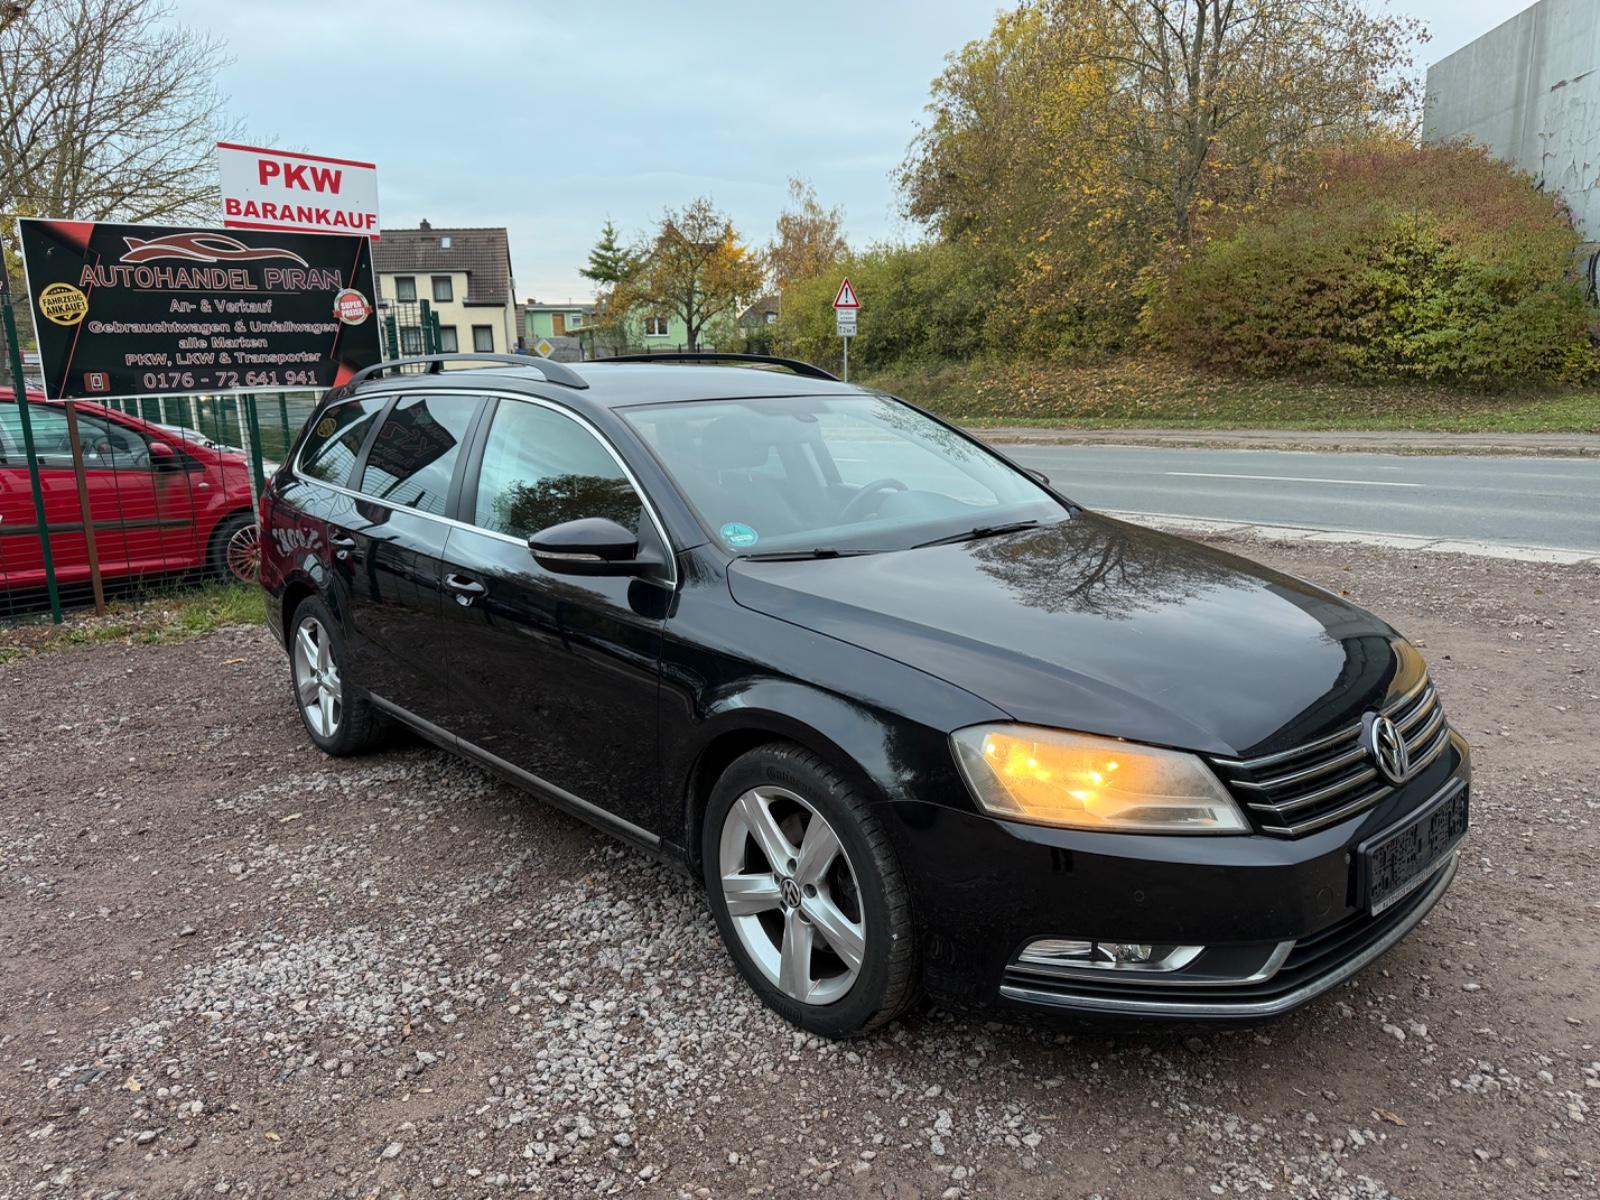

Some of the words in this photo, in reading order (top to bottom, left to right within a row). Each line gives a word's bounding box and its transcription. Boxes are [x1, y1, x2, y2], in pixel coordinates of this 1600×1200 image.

[258, 159, 342, 194] PKW
[225, 198, 377, 230] BARANKAUF
[79, 264, 258, 290] AUTOHANDEL
[264, 268, 342, 290] PIRAN
[42, 295, 83, 306] FAHRZEUG
[169, 298, 197, 313] An-
[200, 298, 213, 313] &
[213, 298, 272, 313] Verkauf
[340, 300, 362, 310] SUPER
[46, 301, 86, 316] ANKAUF!
[88, 321, 230, 335] Gebrauchtwagen
[234, 320, 247, 333] &
[249, 320, 340, 334] Unfallwagen
[178, 336, 208, 349] alle
[211, 336, 268, 349] Marken
[125, 353, 173, 367] PKW,
[175, 352, 215, 365] LKW
[219, 351, 232, 364] &
[233, 351, 322, 365] Transporter
[143, 371, 195, 389] 0176
[215, 371, 240, 389] 72
[245, 370, 280, 387] 641
[285, 369, 318, 386] 941
